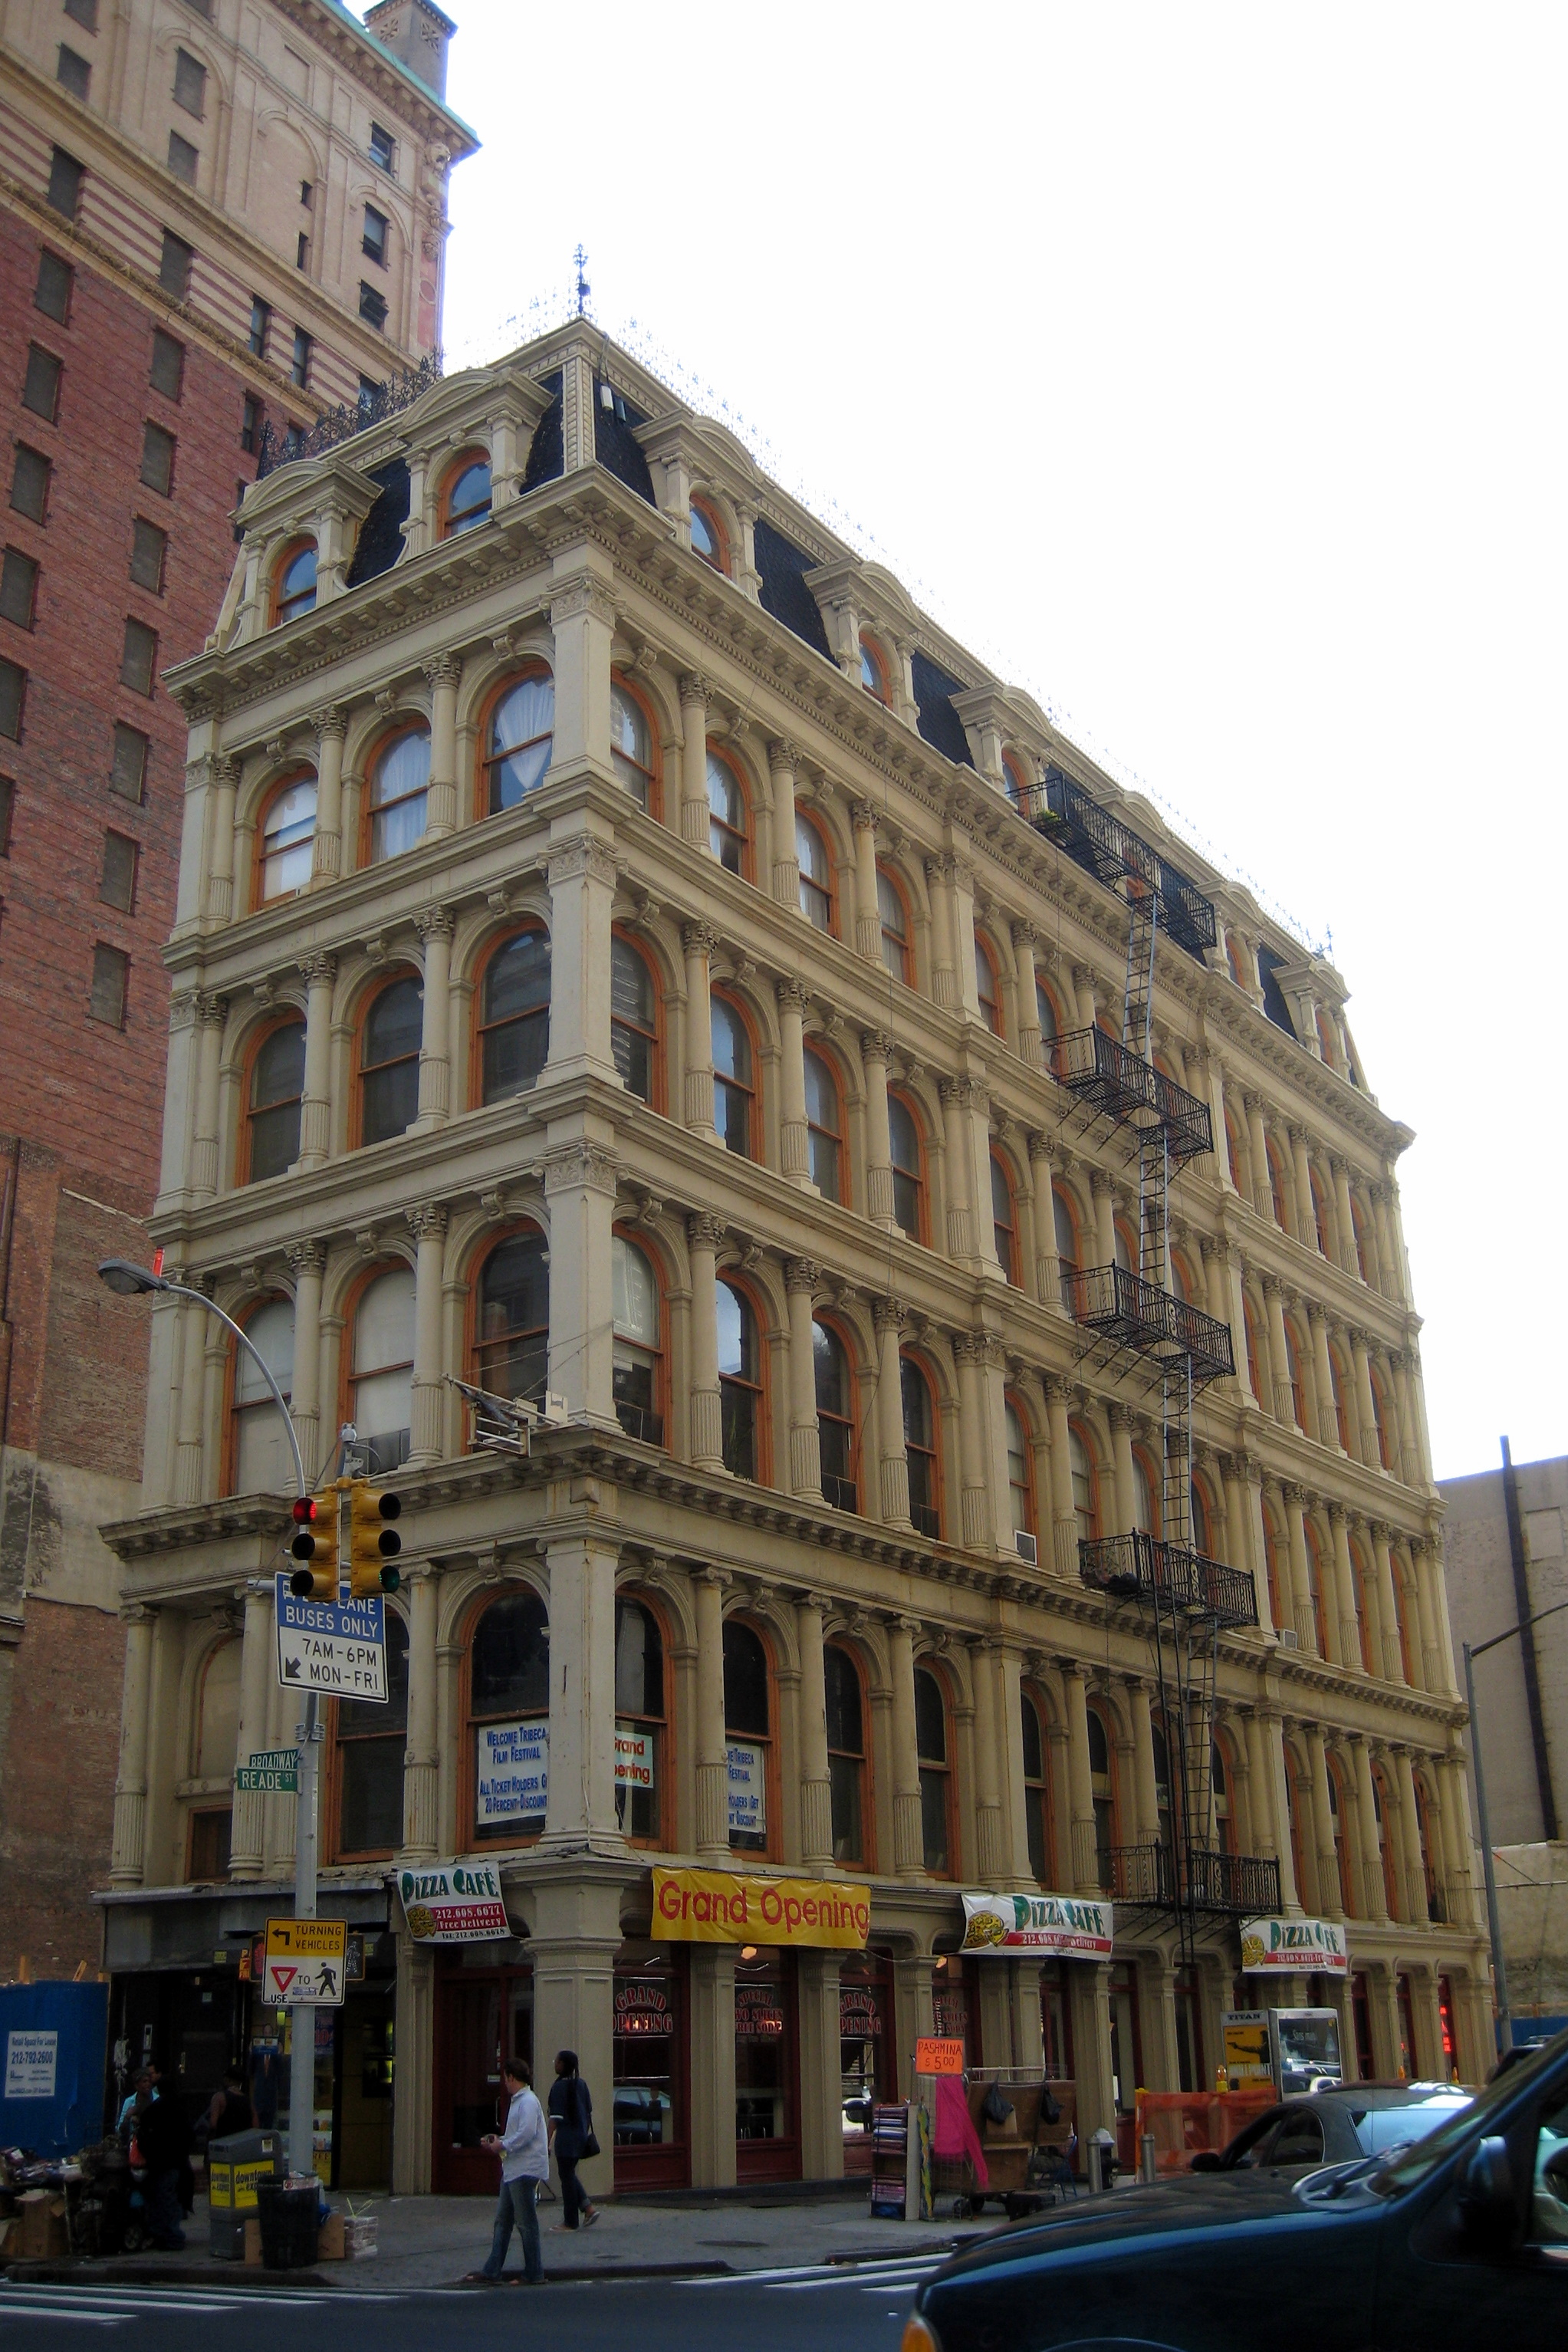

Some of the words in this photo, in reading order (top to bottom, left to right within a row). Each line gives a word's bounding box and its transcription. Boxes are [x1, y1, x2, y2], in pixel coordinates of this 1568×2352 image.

[337, 1595, 376, 1615] LANE
[286, 1605, 334, 1630] BUSES
[341, 1617, 378, 1638] ONLY
[487, 1730, 518, 1747] WELCOME
[519, 1726, 546, 1742] TRIBECA
[251, 1752, 297, 1769] BROADWAY
[492, 1748, 508, 1764] FILM
[511, 1745, 541, 1762] FESTIVAL
[242, 1771, 282, 1789] READE
[284, 1774, 294, 1783] ST
[480, 1780, 490, 1794] ALL
[491, 1778, 511, 1794] TICKET
[512, 1775, 538, 1791] HOLDERS
[453, 1867, 498, 1897] CAFÉ
[436, 1905, 501, 1919] 212.608.6677
[659, 1880, 748, 1924] Grand
[761, 1887, 869, 1940] Opening
[296, 1925, 341, 1936] TURNING
[439, 1919, 459, 1929] Free
[461, 1917, 501, 1928] Delivery
[295, 1939, 340, 1950] VEHICLES
[1315, 1923, 1340, 1955] CFÉ
[297, 1975, 311, 1985] TO
[271, 1994, 288, 2004] USE
[616, 1985, 666, 2012] GRAND
[735, 2008, 750, 2021] WO
[840, 2015, 882, 2035] PENING
[918, 2041, 962, 2056] PASHMINA
